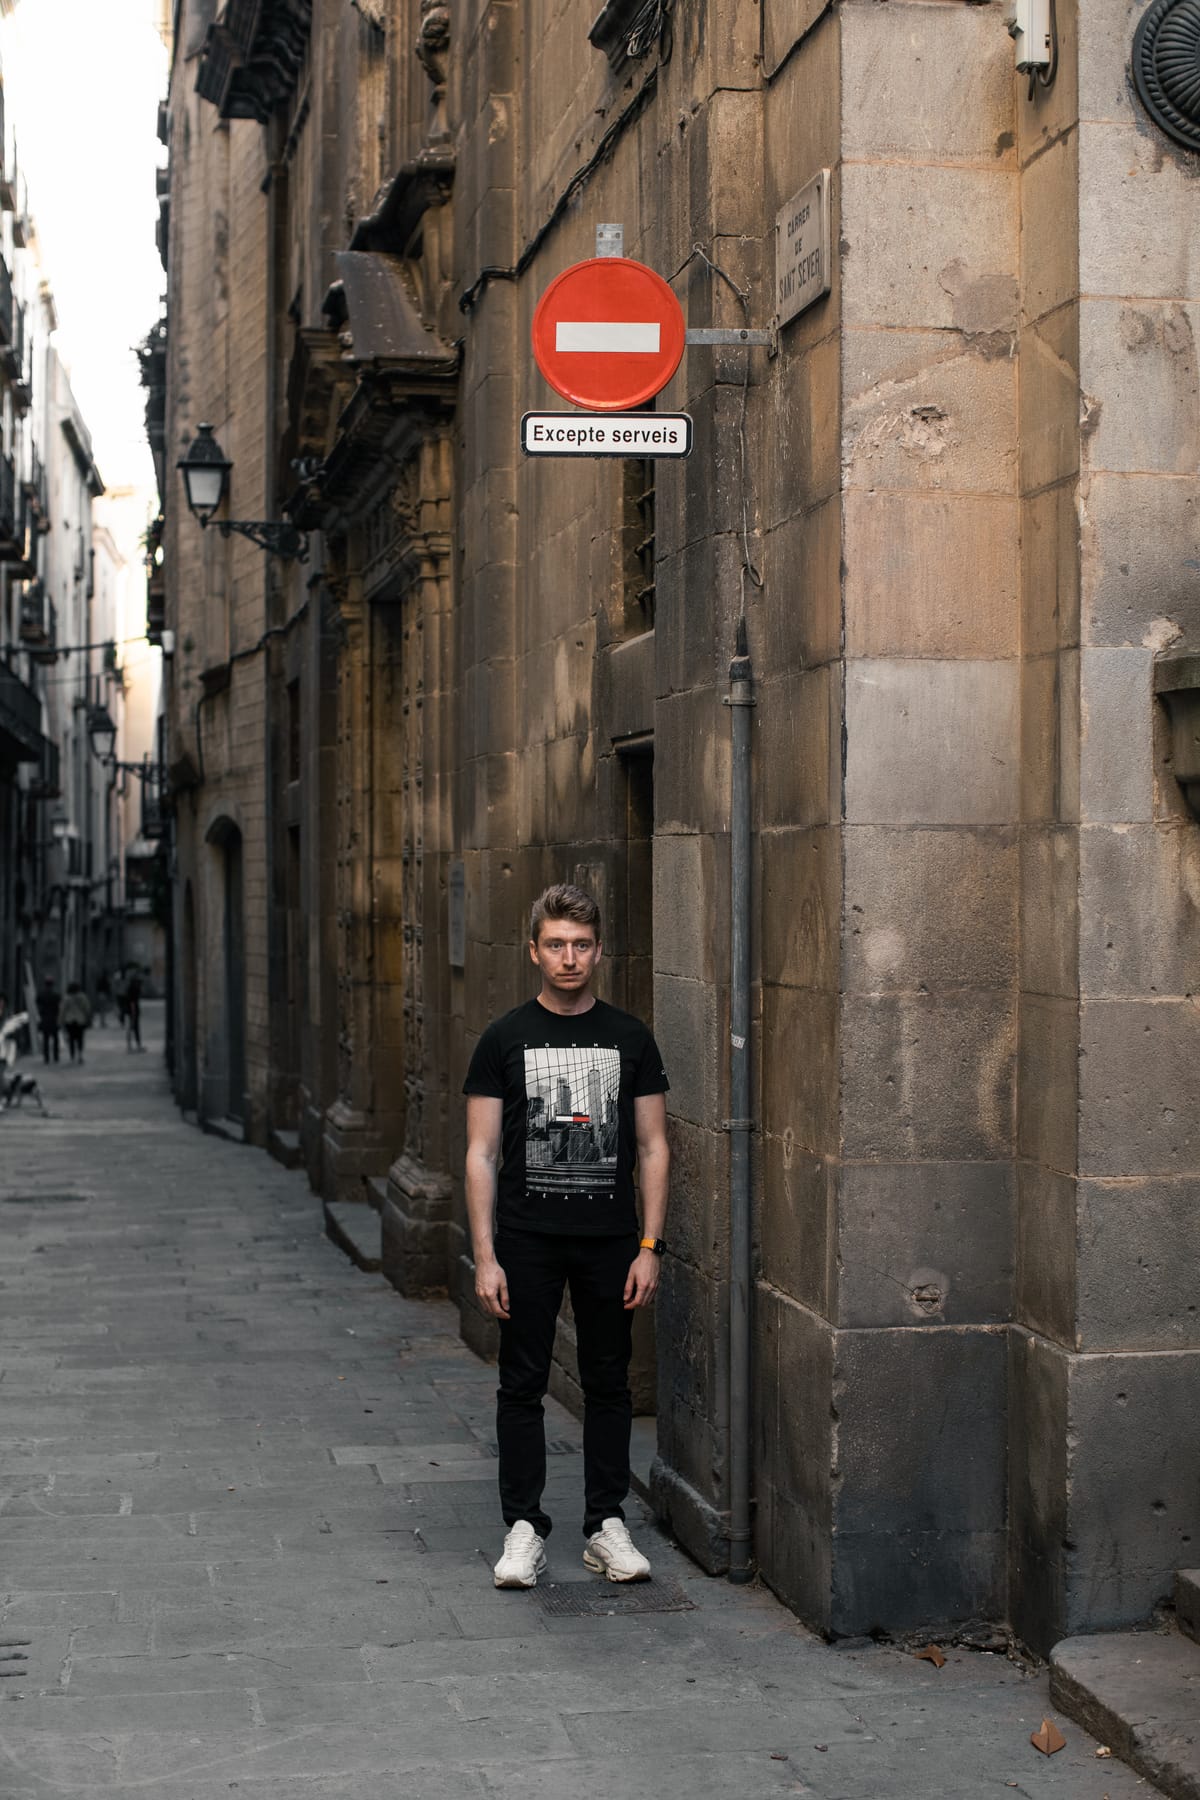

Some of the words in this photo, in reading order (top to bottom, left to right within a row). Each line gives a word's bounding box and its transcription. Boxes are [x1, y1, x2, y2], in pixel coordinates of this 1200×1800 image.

[787, 205, 810, 238] CARRER
[794, 237, 802, 256] DE
[779, 267, 796, 304] SANT
[798, 247, 820, 289] SEVER
[534, 425, 605, 446] Excepte
[611, 426, 678, 444] serveis
